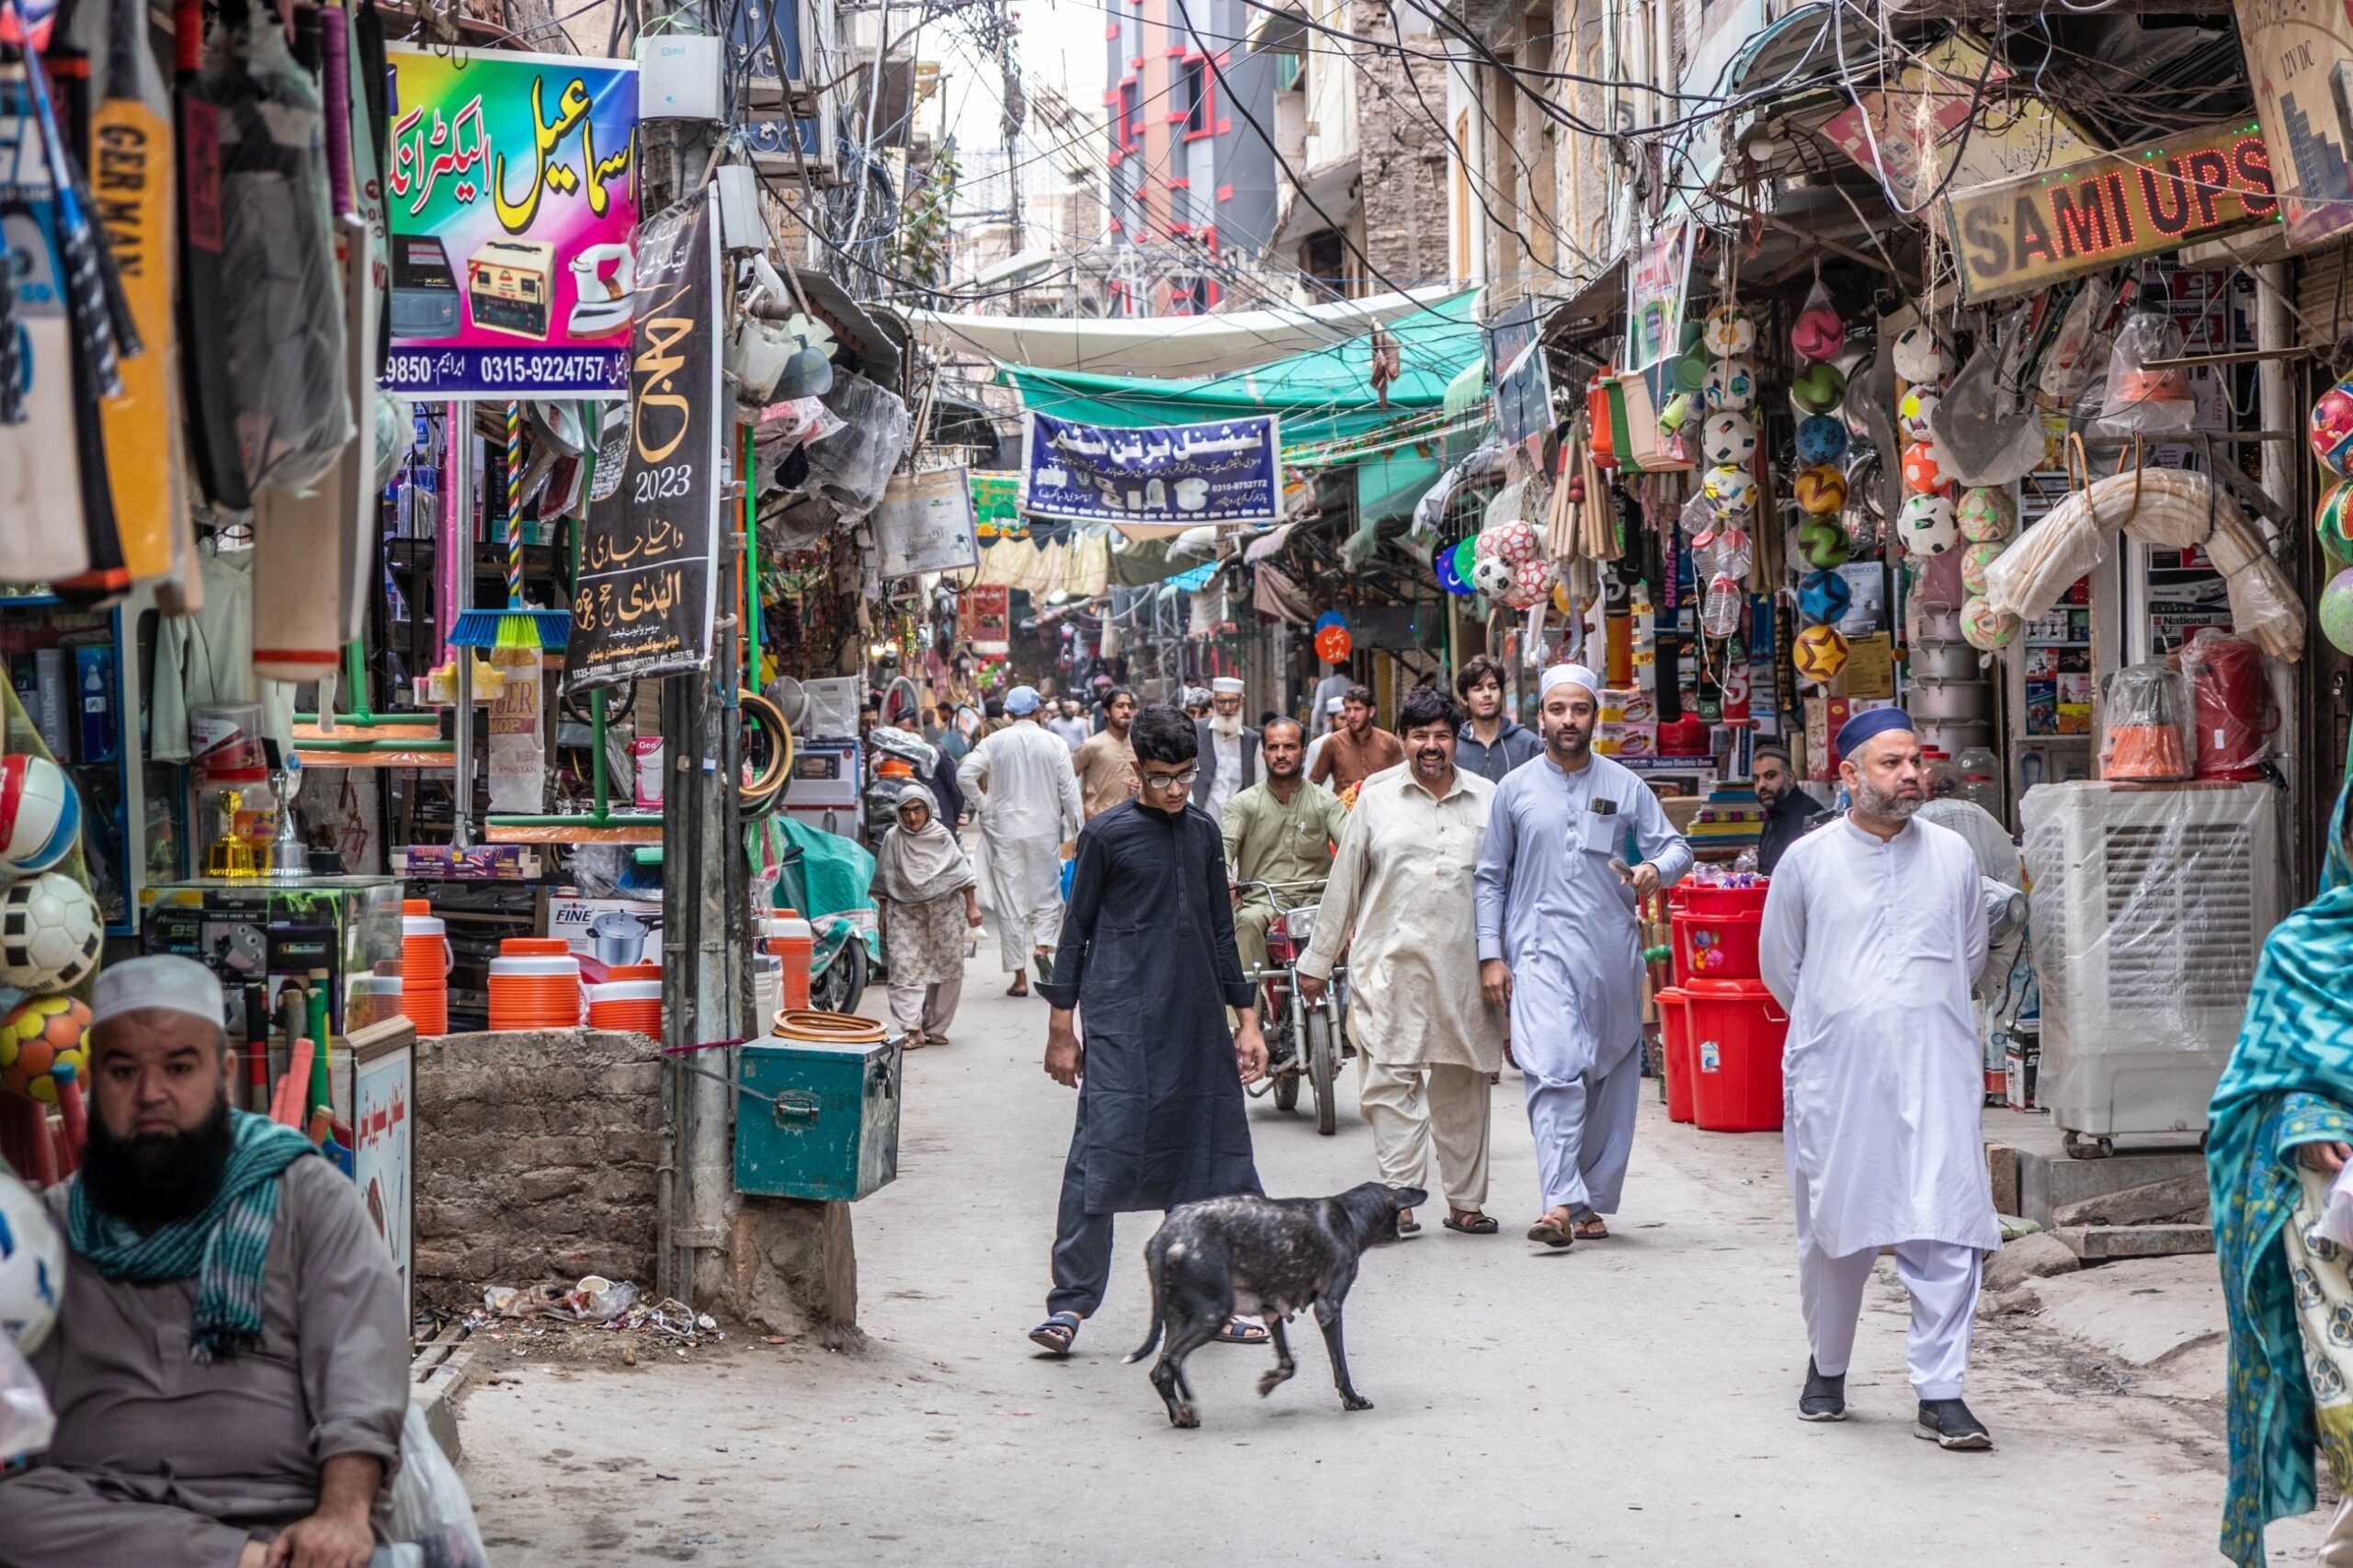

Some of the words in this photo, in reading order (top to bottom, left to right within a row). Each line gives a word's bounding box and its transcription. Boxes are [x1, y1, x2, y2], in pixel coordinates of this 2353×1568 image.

[2296, 40, 2315, 71] DC
[1963, 172, 2137, 279] SAMI
[2137, 138, 2279, 237] UPS
[377, 356, 431, 382] 9850
[481, 355, 605, 382] 0315-9224757
[1109, 434, 1170, 464] برتن
[1173, 423, 1263, 461] نیشنل
[634, 463, 692, 505] 2023
[2164, 616, 2211, 625] National
[44, 677, 56, 728] Wilson
[639, 741, 656, 749] Geo
[1674, 758, 1697, 767] Electric
[556, 909, 592, 922] FINE
